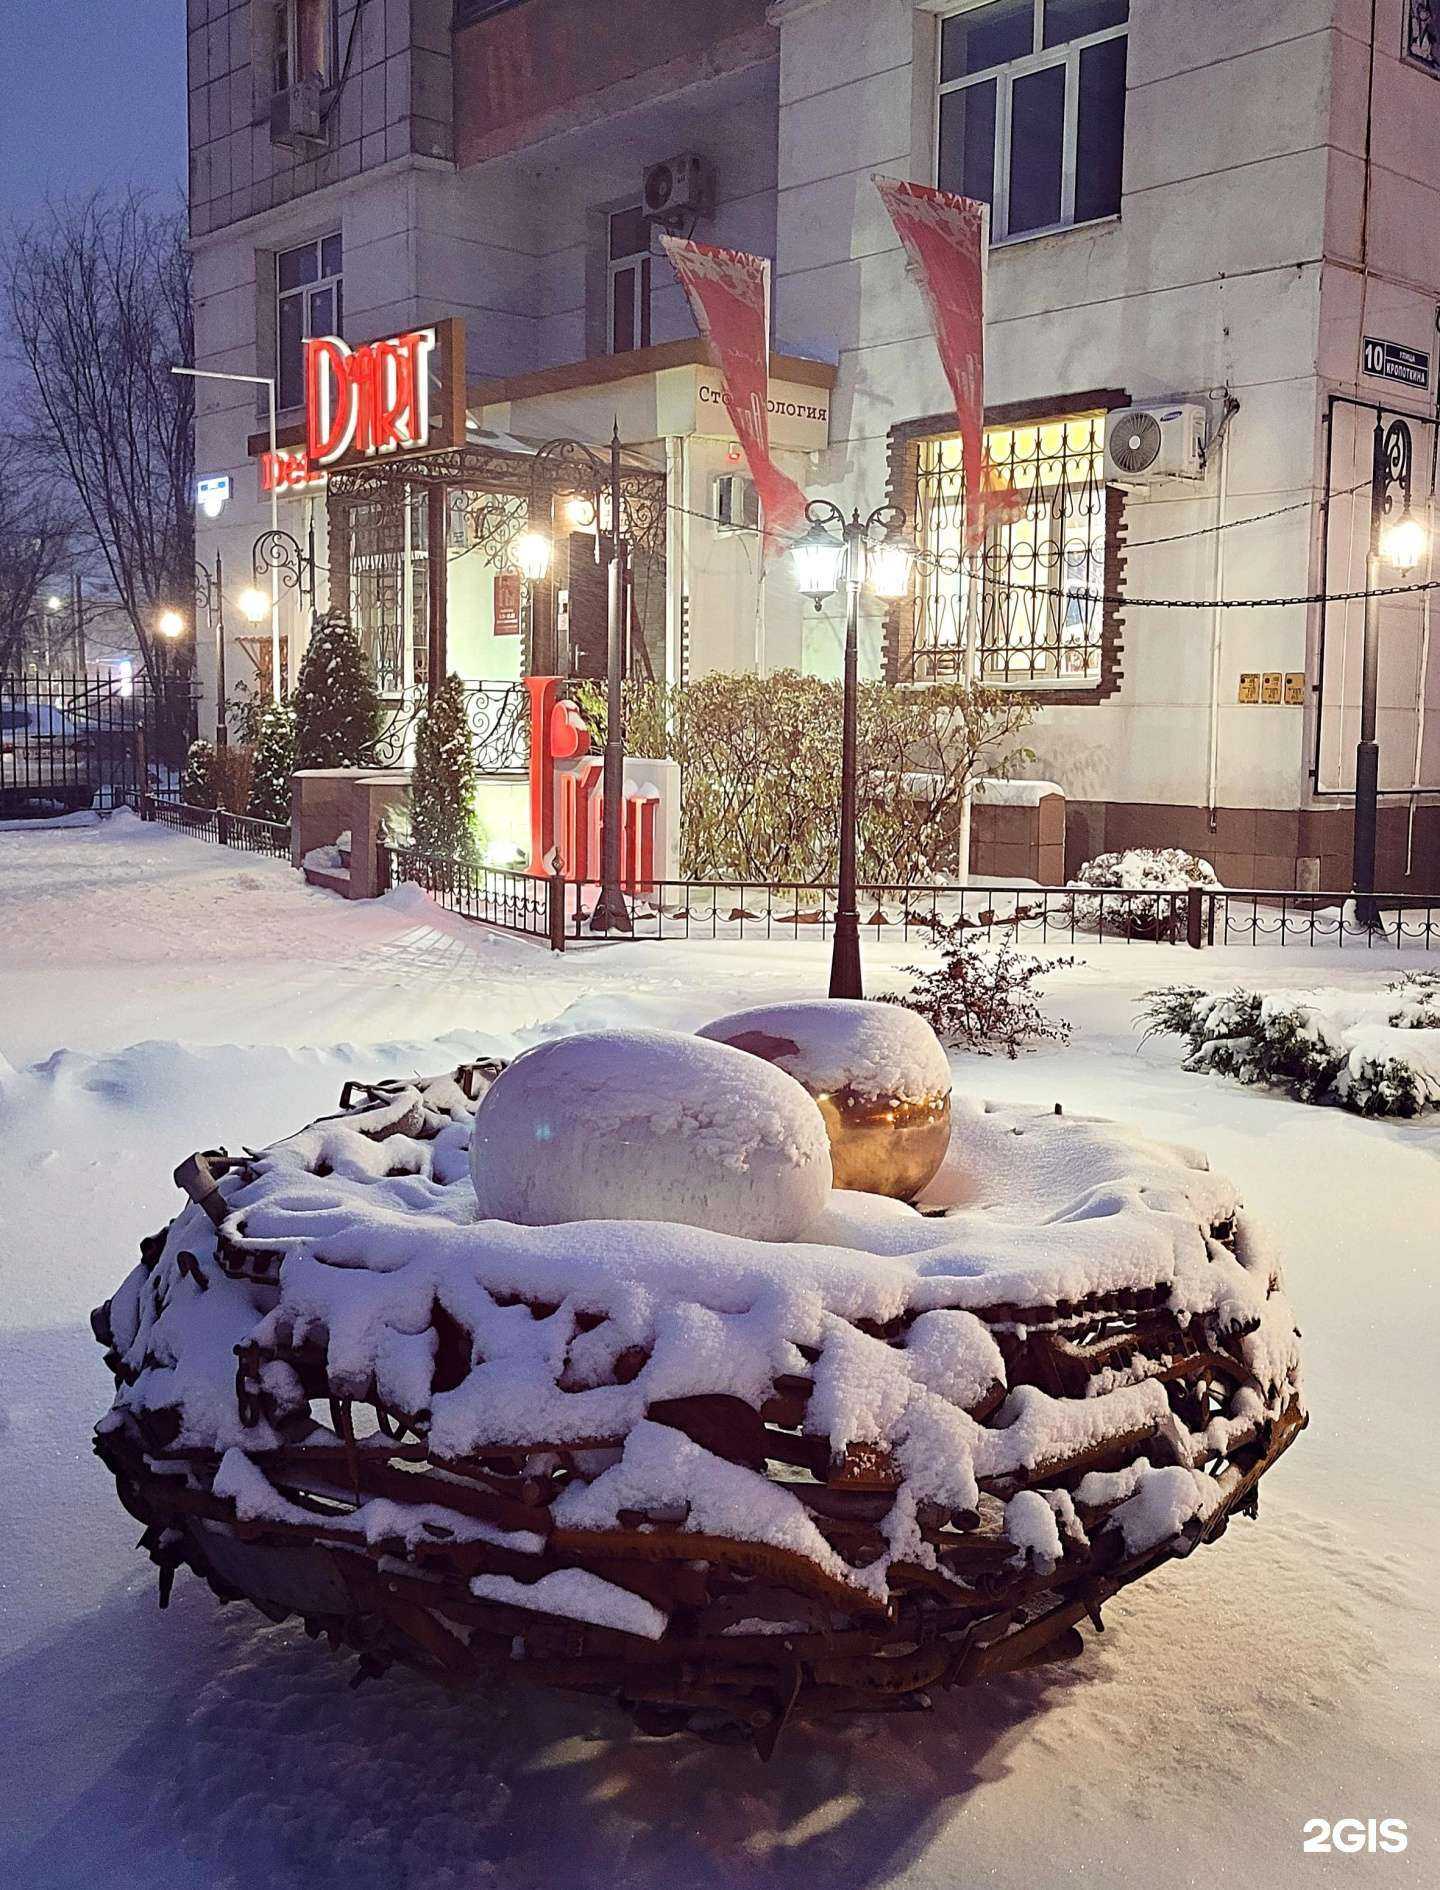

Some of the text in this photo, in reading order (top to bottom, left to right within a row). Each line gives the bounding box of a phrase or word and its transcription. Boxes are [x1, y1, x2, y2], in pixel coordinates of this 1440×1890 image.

[1365, 343, 1384, 371] 10
[1386, 362, 1426, 383] КРОПОТКИНА
[699, 385, 828, 422] Стоология
